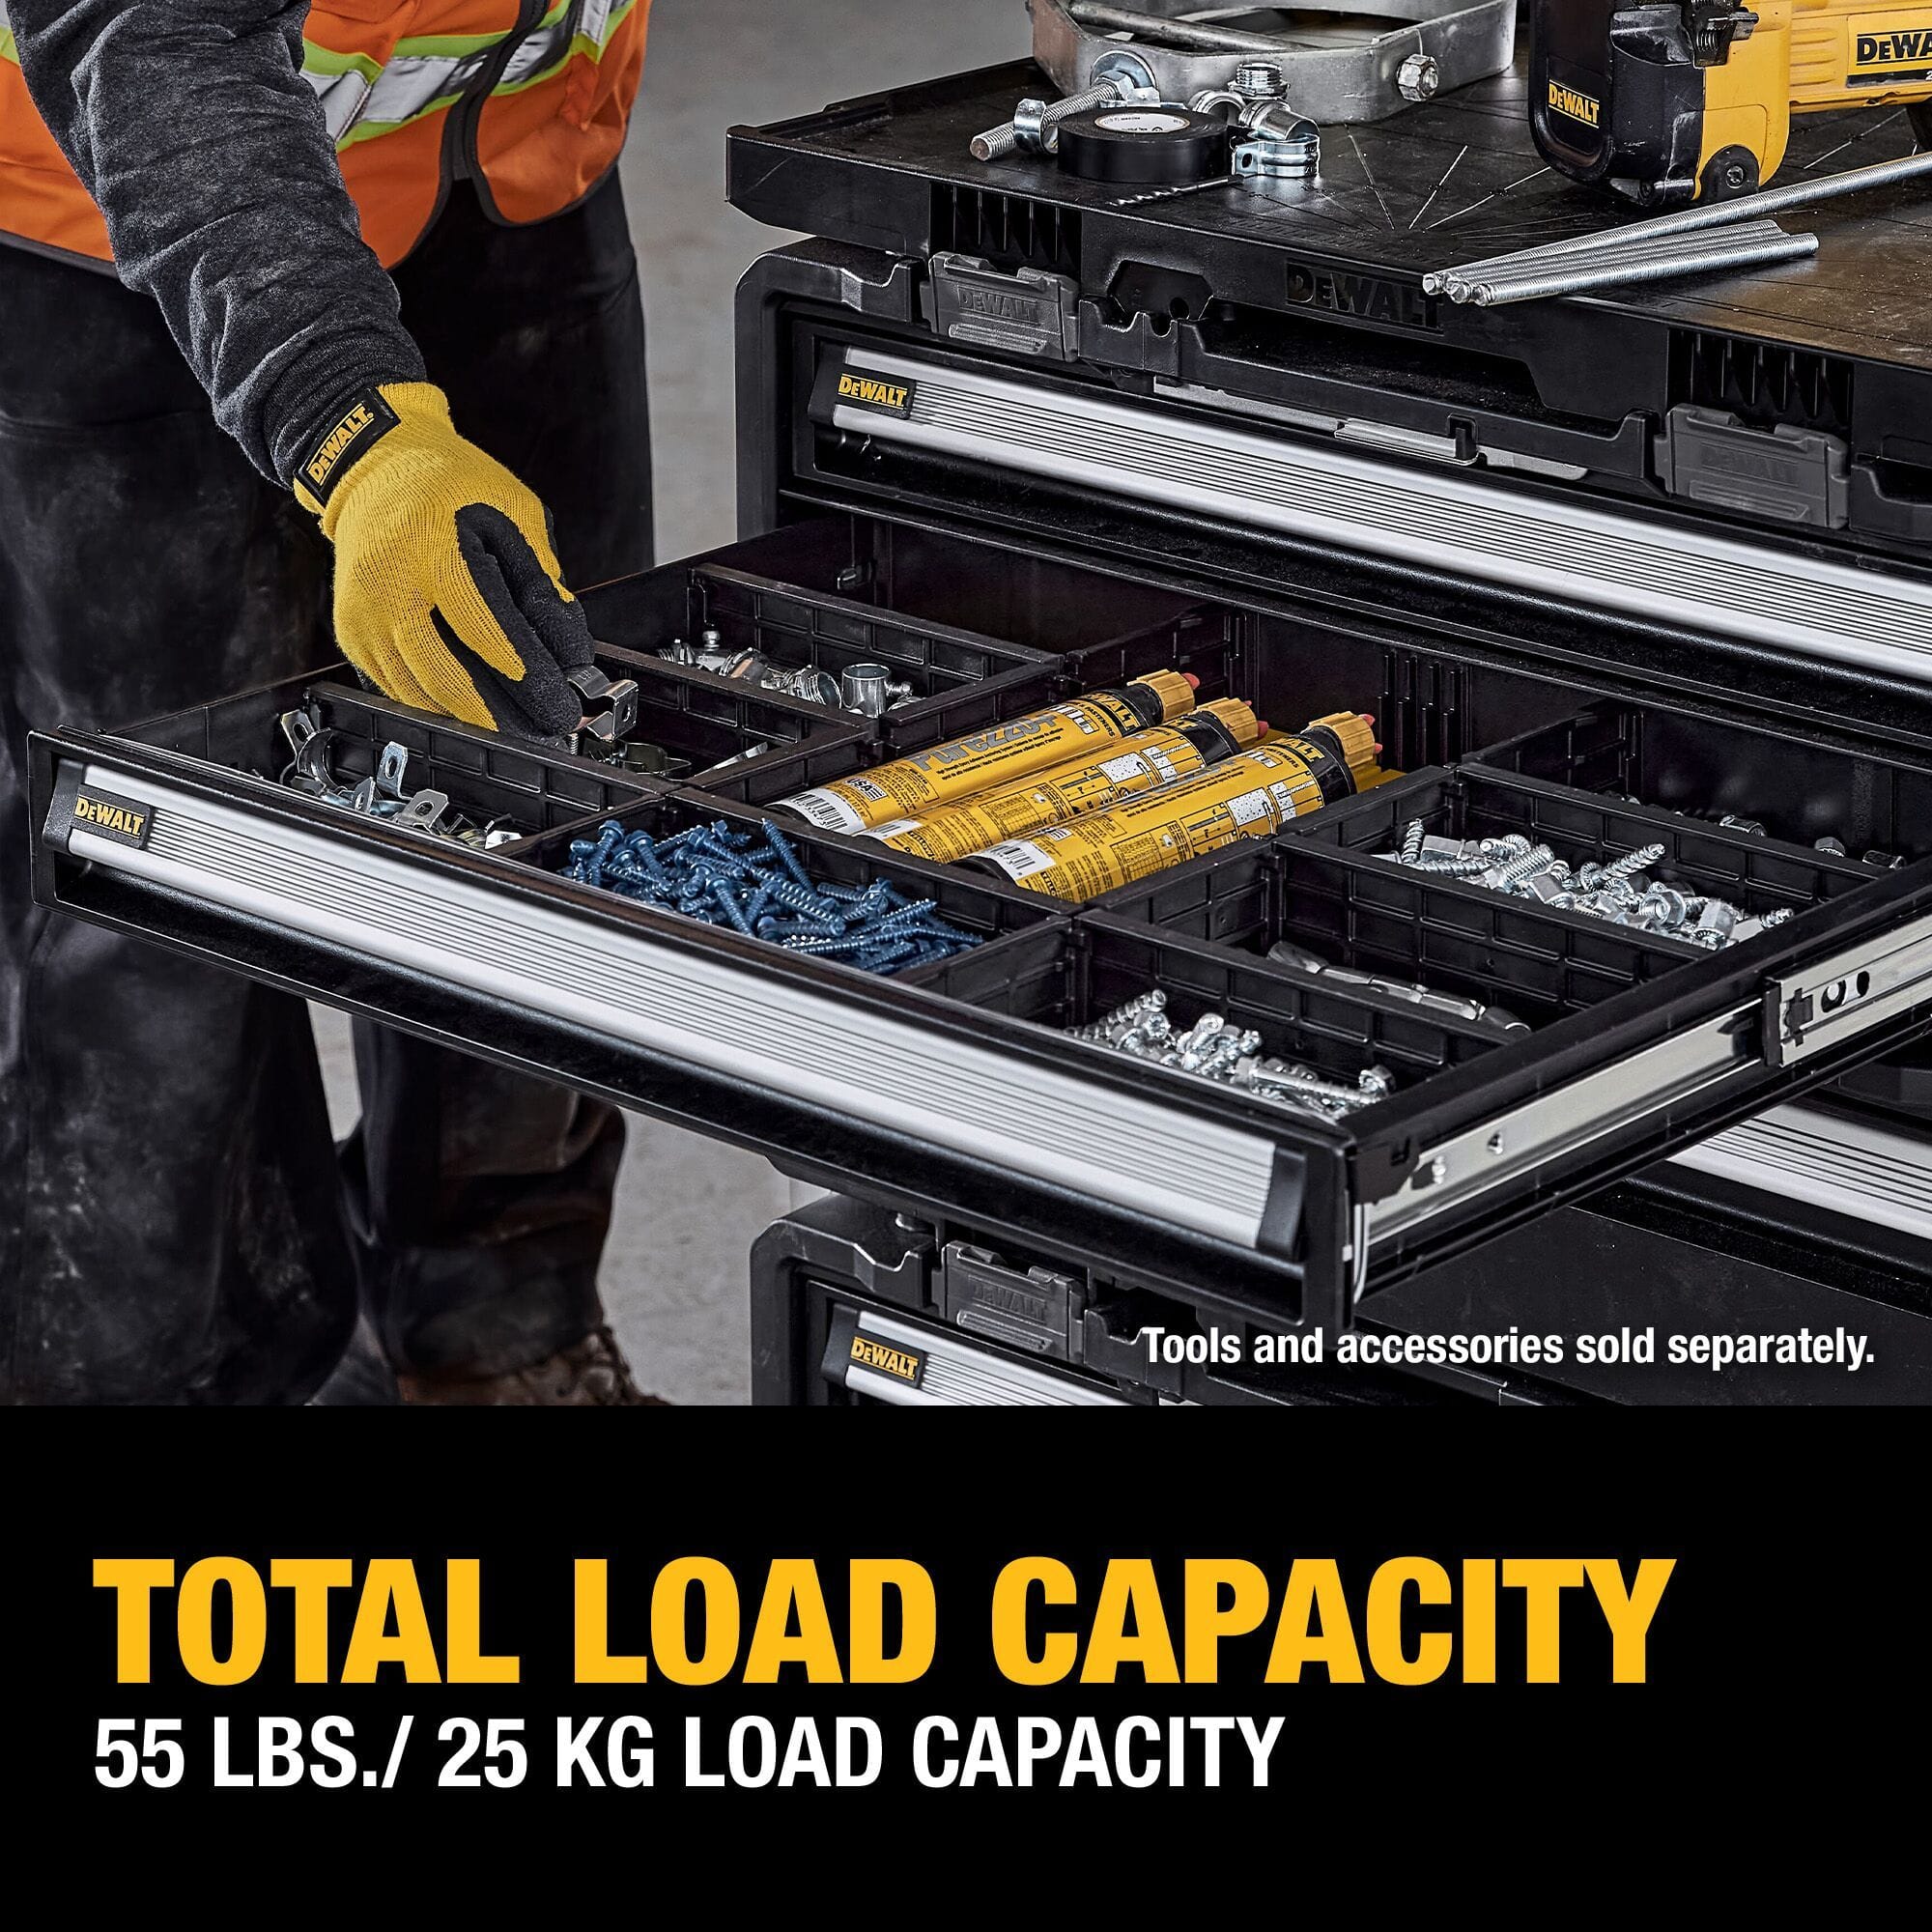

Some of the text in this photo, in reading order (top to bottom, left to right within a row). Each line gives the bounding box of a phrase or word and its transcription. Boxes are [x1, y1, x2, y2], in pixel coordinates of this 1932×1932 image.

[1548, 83, 1600, 124] DEWALT
[959, 289, 1039, 323] DEWALT
[1286, 263, 1444, 330] DEWALT
[838, 376, 907, 408] DEWALT
[308, 406, 369, 484] DEWALT
[74, 796, 145, 837] DEWALT
[851, 1339, 919, 1378] DEWALT
